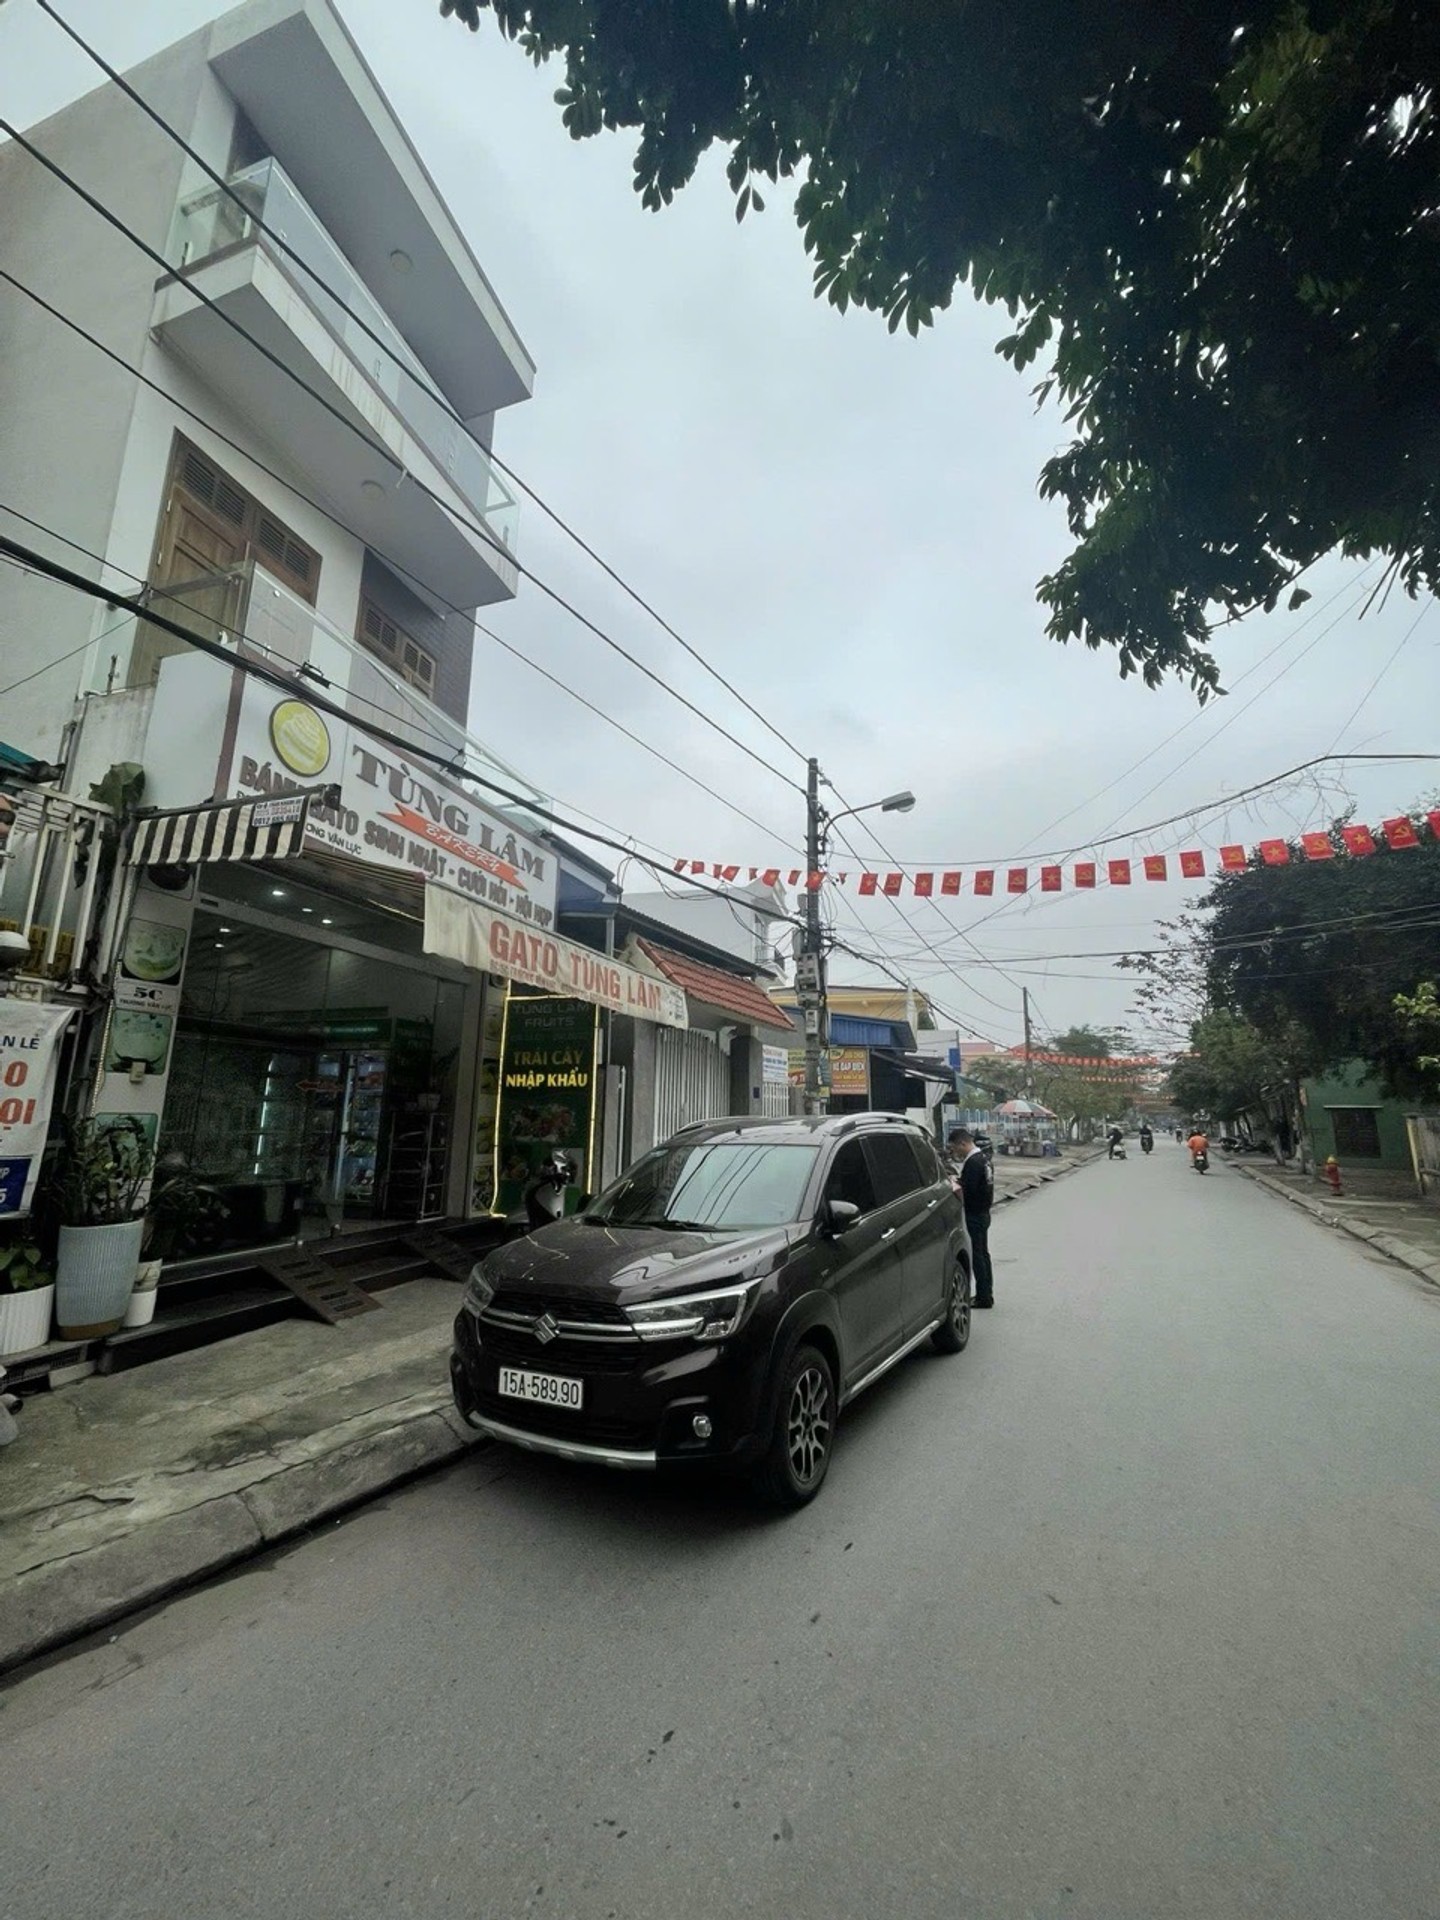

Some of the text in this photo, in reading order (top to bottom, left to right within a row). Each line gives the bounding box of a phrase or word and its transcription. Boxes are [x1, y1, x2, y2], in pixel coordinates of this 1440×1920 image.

[352, 745, 546, 882] TÙNG LÂM
[364, 820, 405, 860] SINH
[407, 839, 447, 879] NHẬT
[425, 822, 501, 873] BAKERY
[488, 920, 559, 978] GATO
[570, 951, 622, 1001] TÙNG
[626, 974, 662, 1012] LÂM
[505, 1065, 589, 1091] NHẬP KHẨU
[503, 1371, 579, 1405] 15A-589.90
